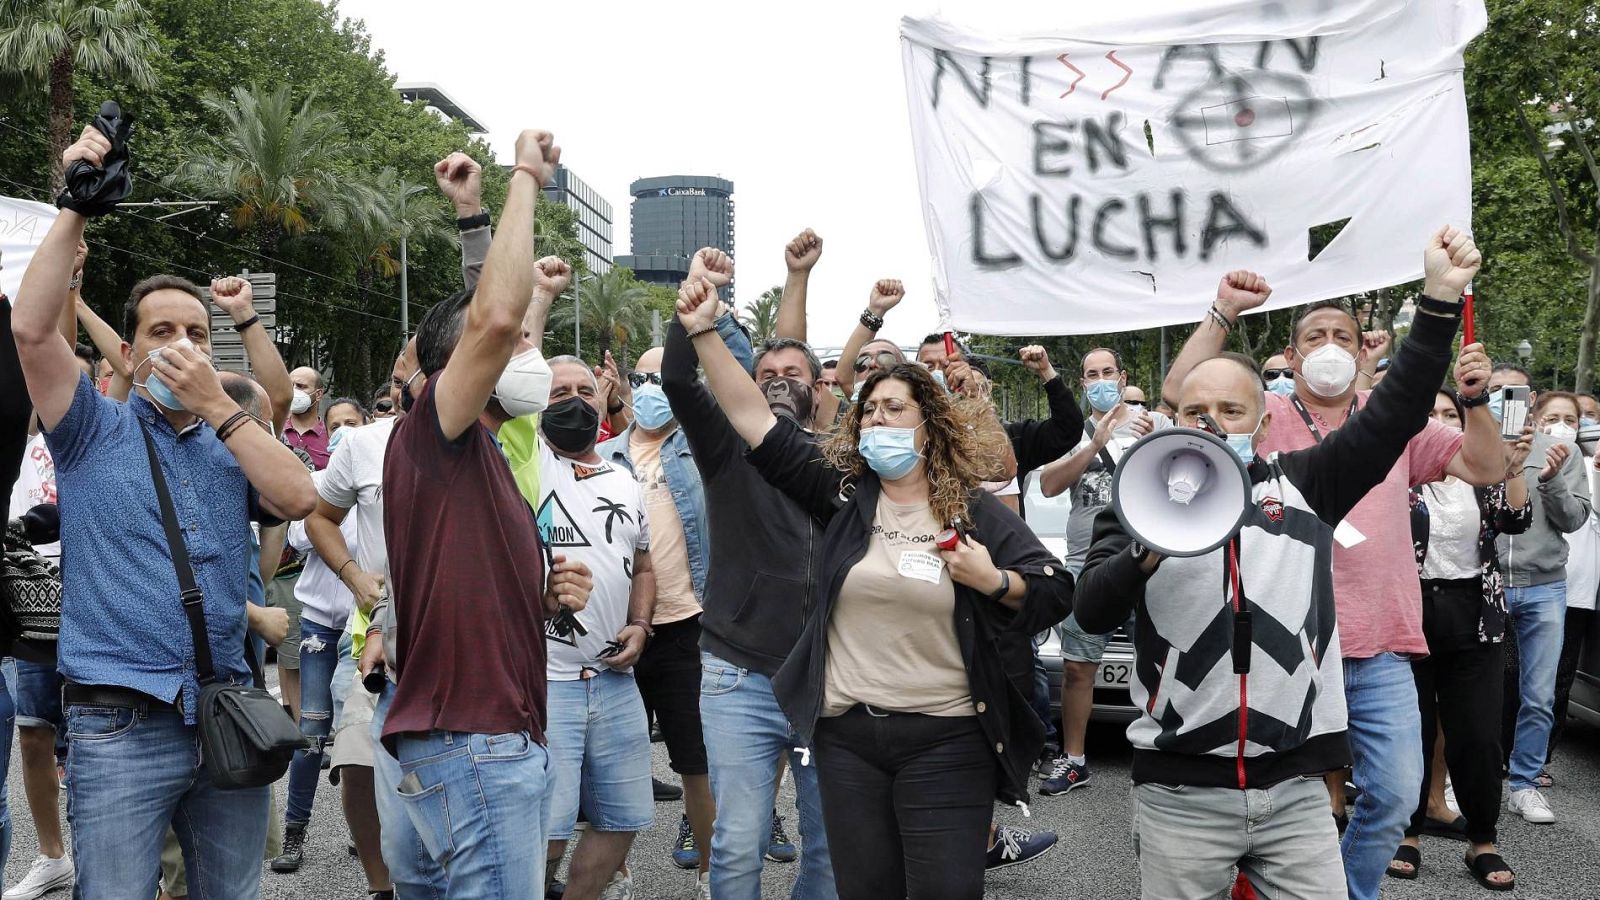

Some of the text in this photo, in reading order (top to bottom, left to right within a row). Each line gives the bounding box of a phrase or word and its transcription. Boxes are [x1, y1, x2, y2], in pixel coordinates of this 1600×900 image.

[931, 35, 1321, 110] NISSAN
[1032, 110, 1130, 177] EN
[668, 187, 706, 196] CaixaBank
[969, 189, 1268, 269] LUCHA
[871, 525, 900, 540] PERECT
[1103, 664, 1132, 684] 62
